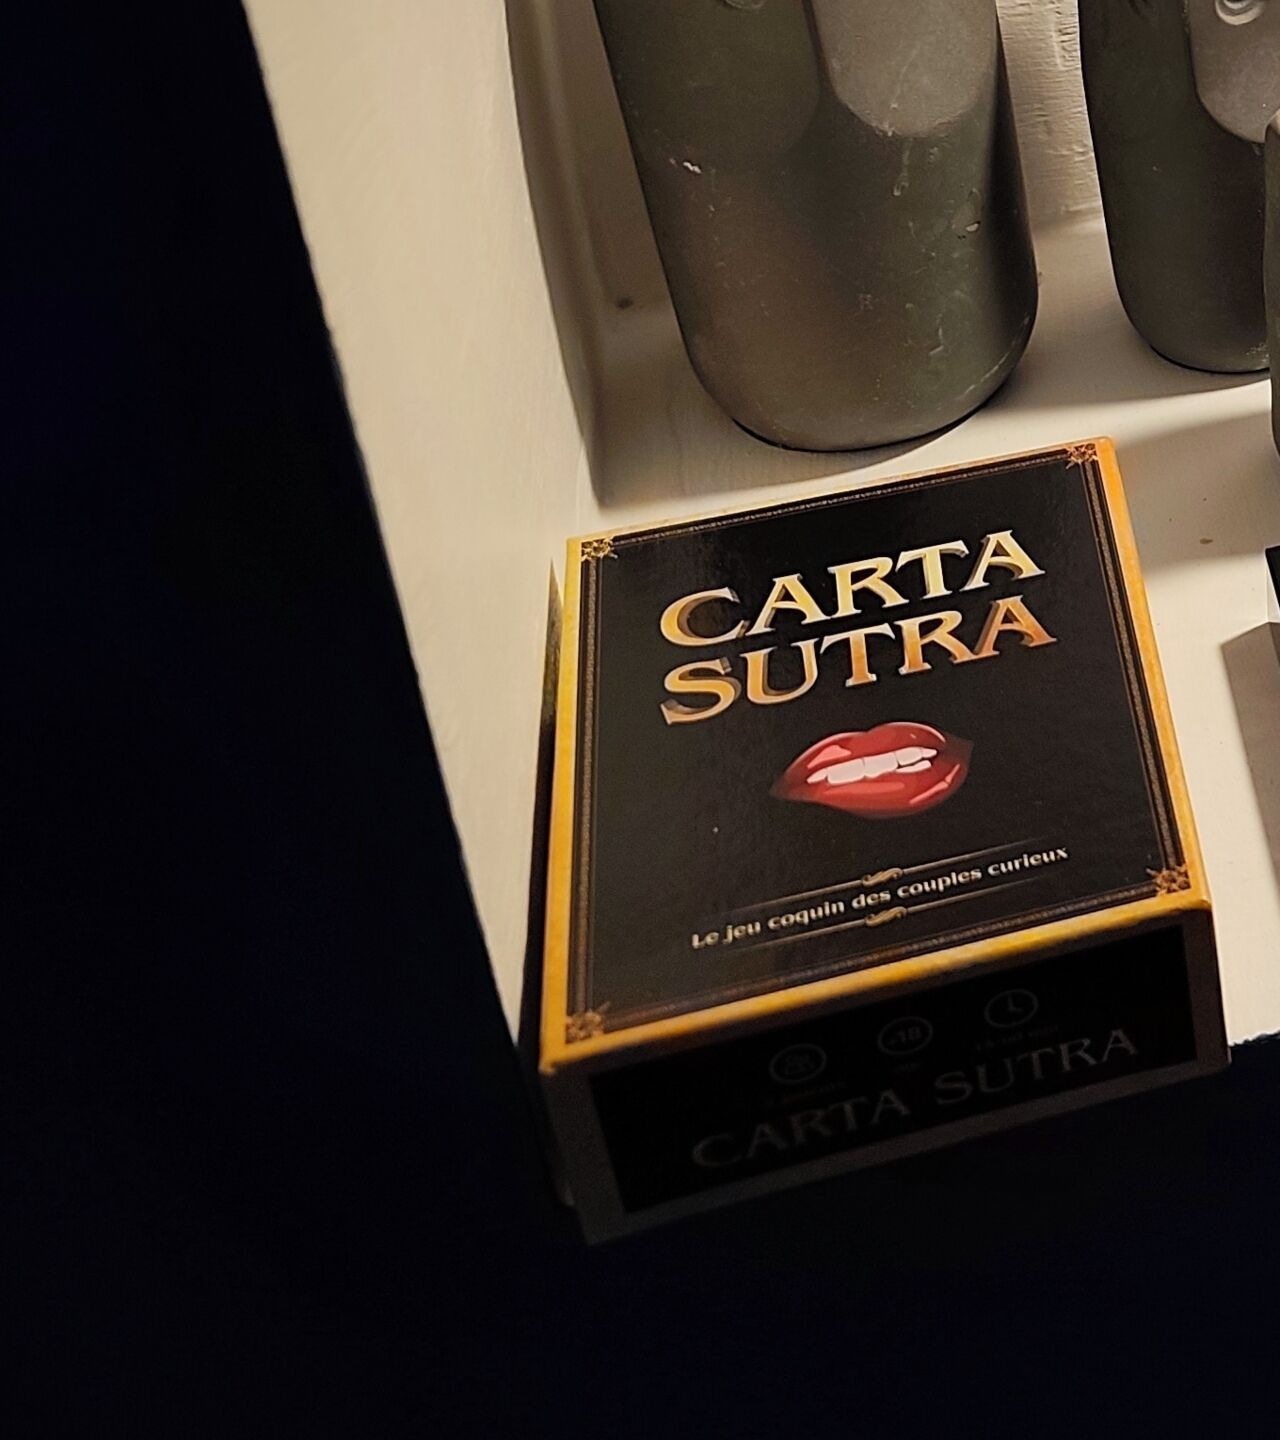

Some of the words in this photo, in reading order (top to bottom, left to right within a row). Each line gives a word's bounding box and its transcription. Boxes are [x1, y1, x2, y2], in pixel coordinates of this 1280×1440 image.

[659, 528, 1046, 650] CARTA
[659, 593, 1058, 727] SUTRA
[690, 930, 719, 951] Le
[721, 920, 763, 947] jeu
[767, 898, 846, 935] coquin
[851, 882, 893, 911] des
[895, 864, 983, 903] couples
[986, 844, 1070, 880] curieux
[692, 1087, 914, 1171] CARTA
[933, 1024, 1140, 1106] SUTRA
